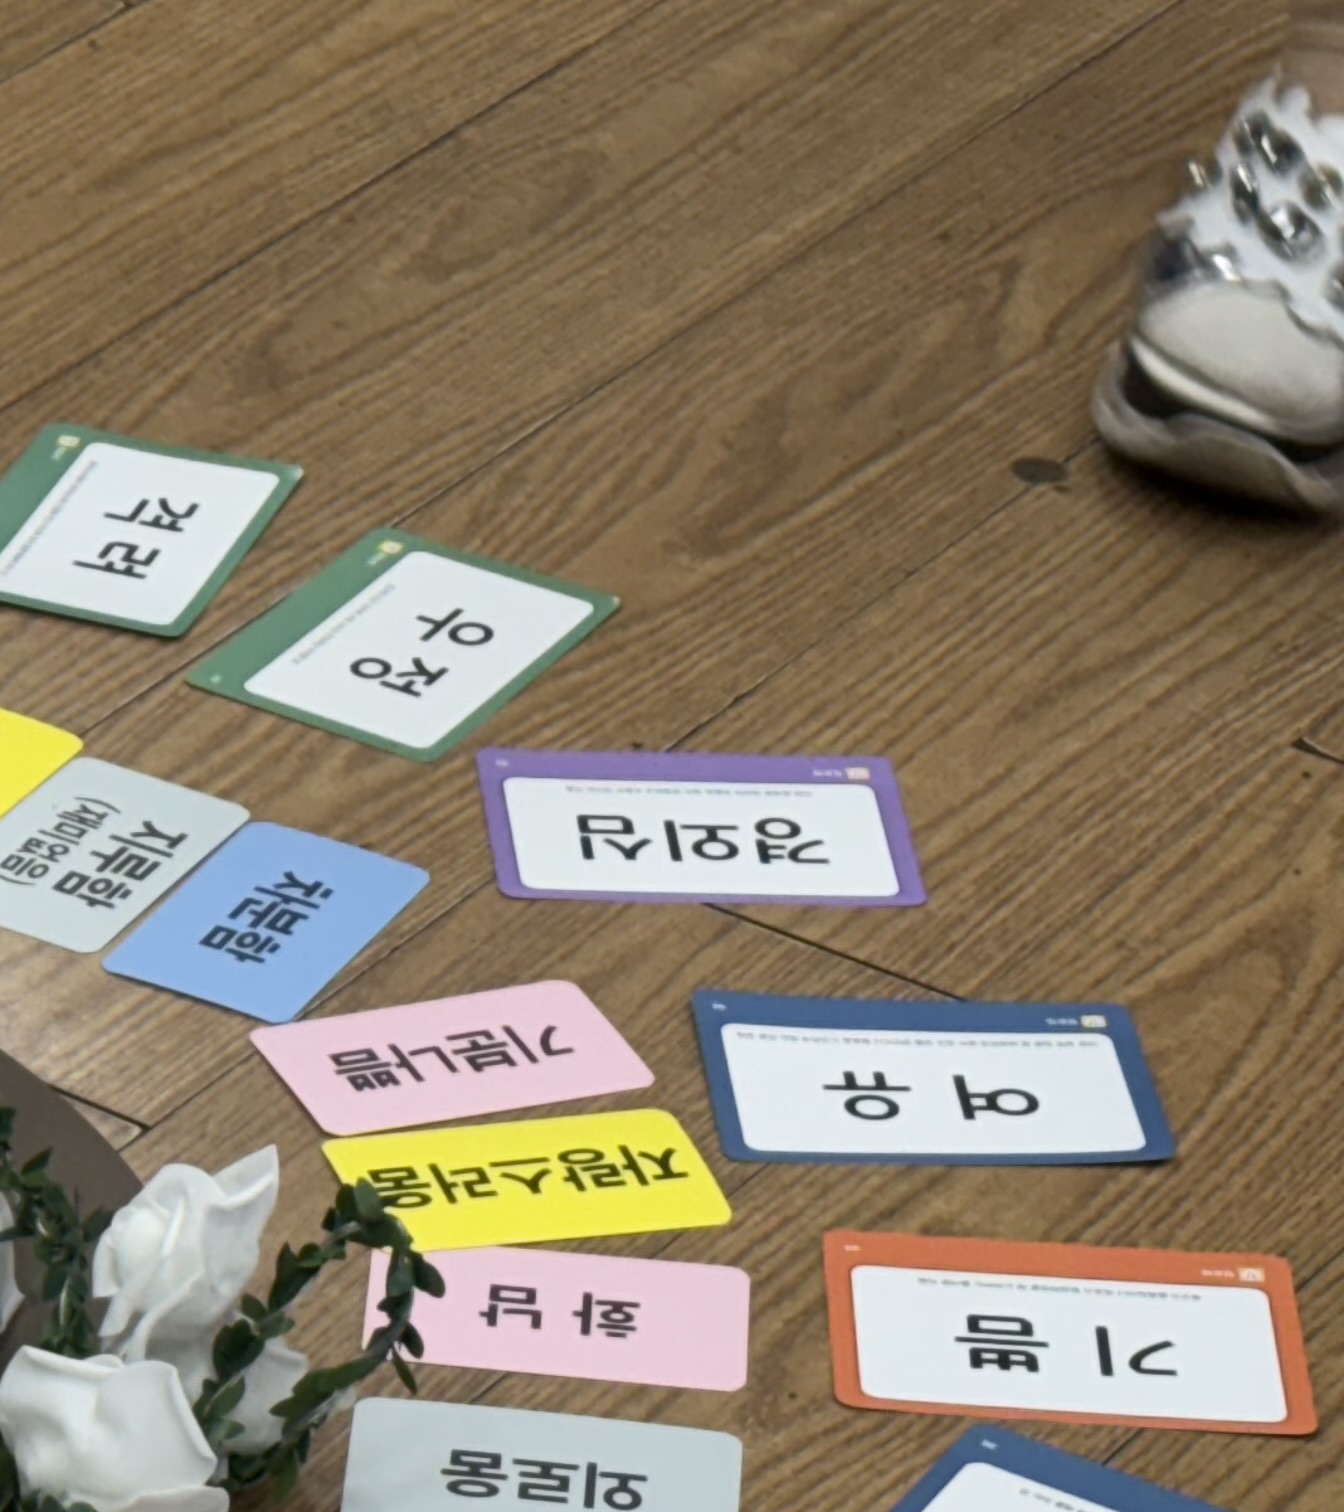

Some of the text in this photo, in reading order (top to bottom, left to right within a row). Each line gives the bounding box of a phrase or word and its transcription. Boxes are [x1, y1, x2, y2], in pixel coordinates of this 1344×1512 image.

[51, 819, 190, 911] 지루함
[575, 813, 831, 865] 경외심
[198, 870, 334, 964] 차분함
[329, 1024, 575, 1093] 기분나쁨
[367, 1144, 689, 1209] 자랑스러움
[440, 1448, 648, 1512] 외로움
